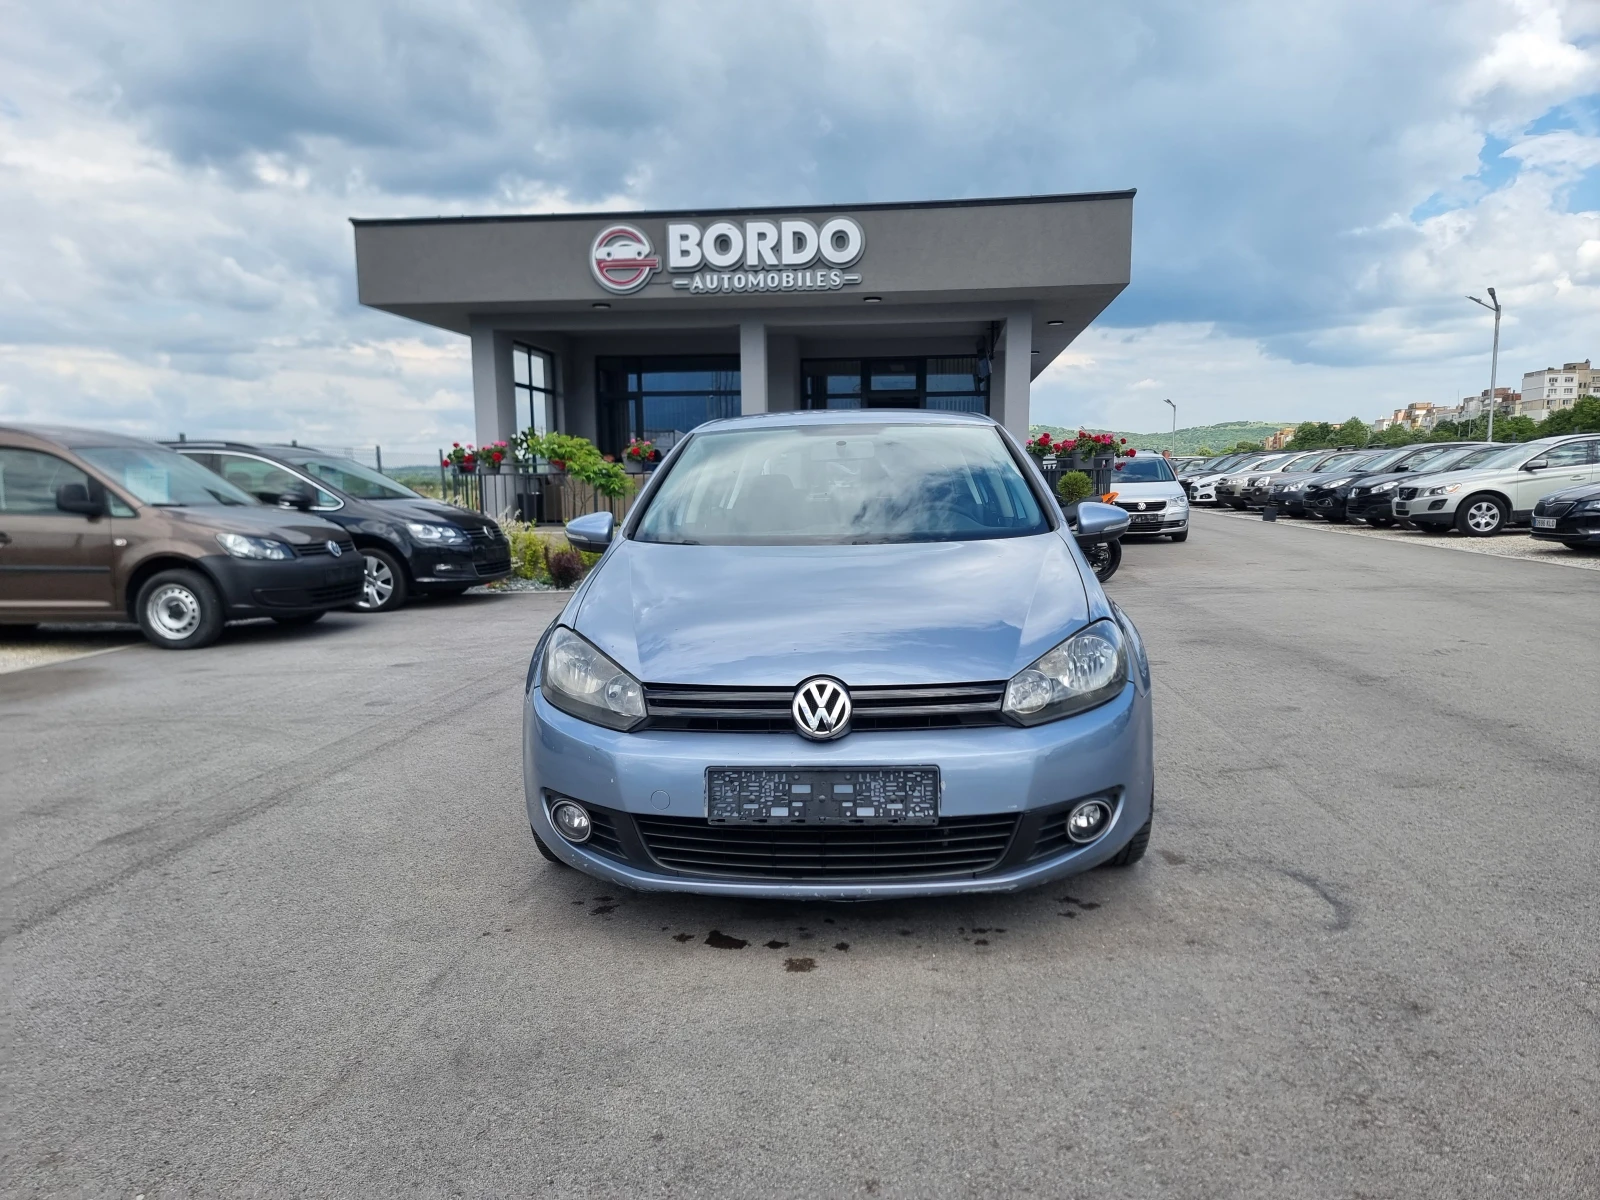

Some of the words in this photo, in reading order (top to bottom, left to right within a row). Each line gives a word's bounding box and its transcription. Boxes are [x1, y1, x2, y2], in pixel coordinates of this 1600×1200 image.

[668, 218, 862, 268] BORDO
[691, 271, 841, 290] AUTOMOBILES
[794, 679, 850, 735] VW
